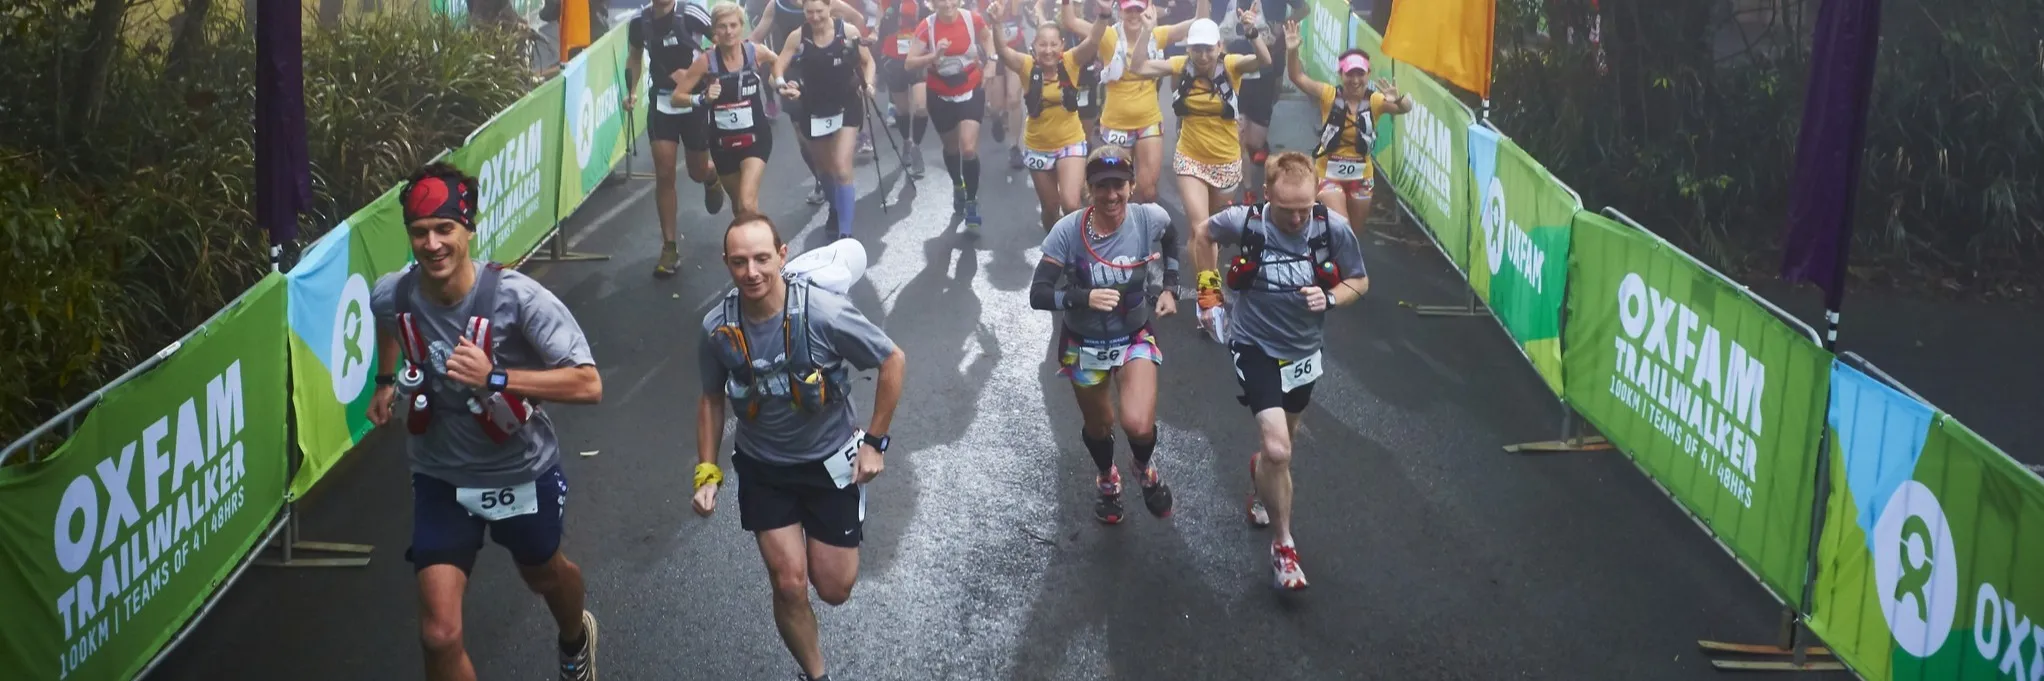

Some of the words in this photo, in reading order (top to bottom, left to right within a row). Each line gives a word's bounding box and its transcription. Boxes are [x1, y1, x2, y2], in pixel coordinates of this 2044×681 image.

[730, 113, 738, 123] 3
[826, 119, 832, 128] 3
[1110, 134, 1126, 145] 20
[1404, 92, 1452, 176] OXFAM
[477, 117, 542, 214] OXFAM
[1029, 157, 1044, 168] 20
[1338, 164, 1355, 175] 20
[1507, 219, 1545, 295] OXFAM
[1096, 349, 1120, 361] 56
[1294, 359, 1312, 379] 56
[1618, 272, 1765, 437] OXFAM
[1609, 374, 1641, 413] 100KM
[1649, 402, 1683, 446] TEAMS
[1684, 434, 1699, 459] OF
[1700, 450, 1708, 470] 4
[1717, 462, 1753, 510] 48HRS
[1614, 335, 1757, 483] TRAILWALKER
[54, 358, 245, 574] OXFAM
[481, 487, 515, 509] 56
[57, 440, 246, 642] TRAILWALKER
[59, 619, 110, 681] 100KM
[124, 562, 170, 622] TEAMS
[174, 548, 189, 574] OF
[193, 530, 200, 552] 4
[210, 485, 245, 534] 48HRS
